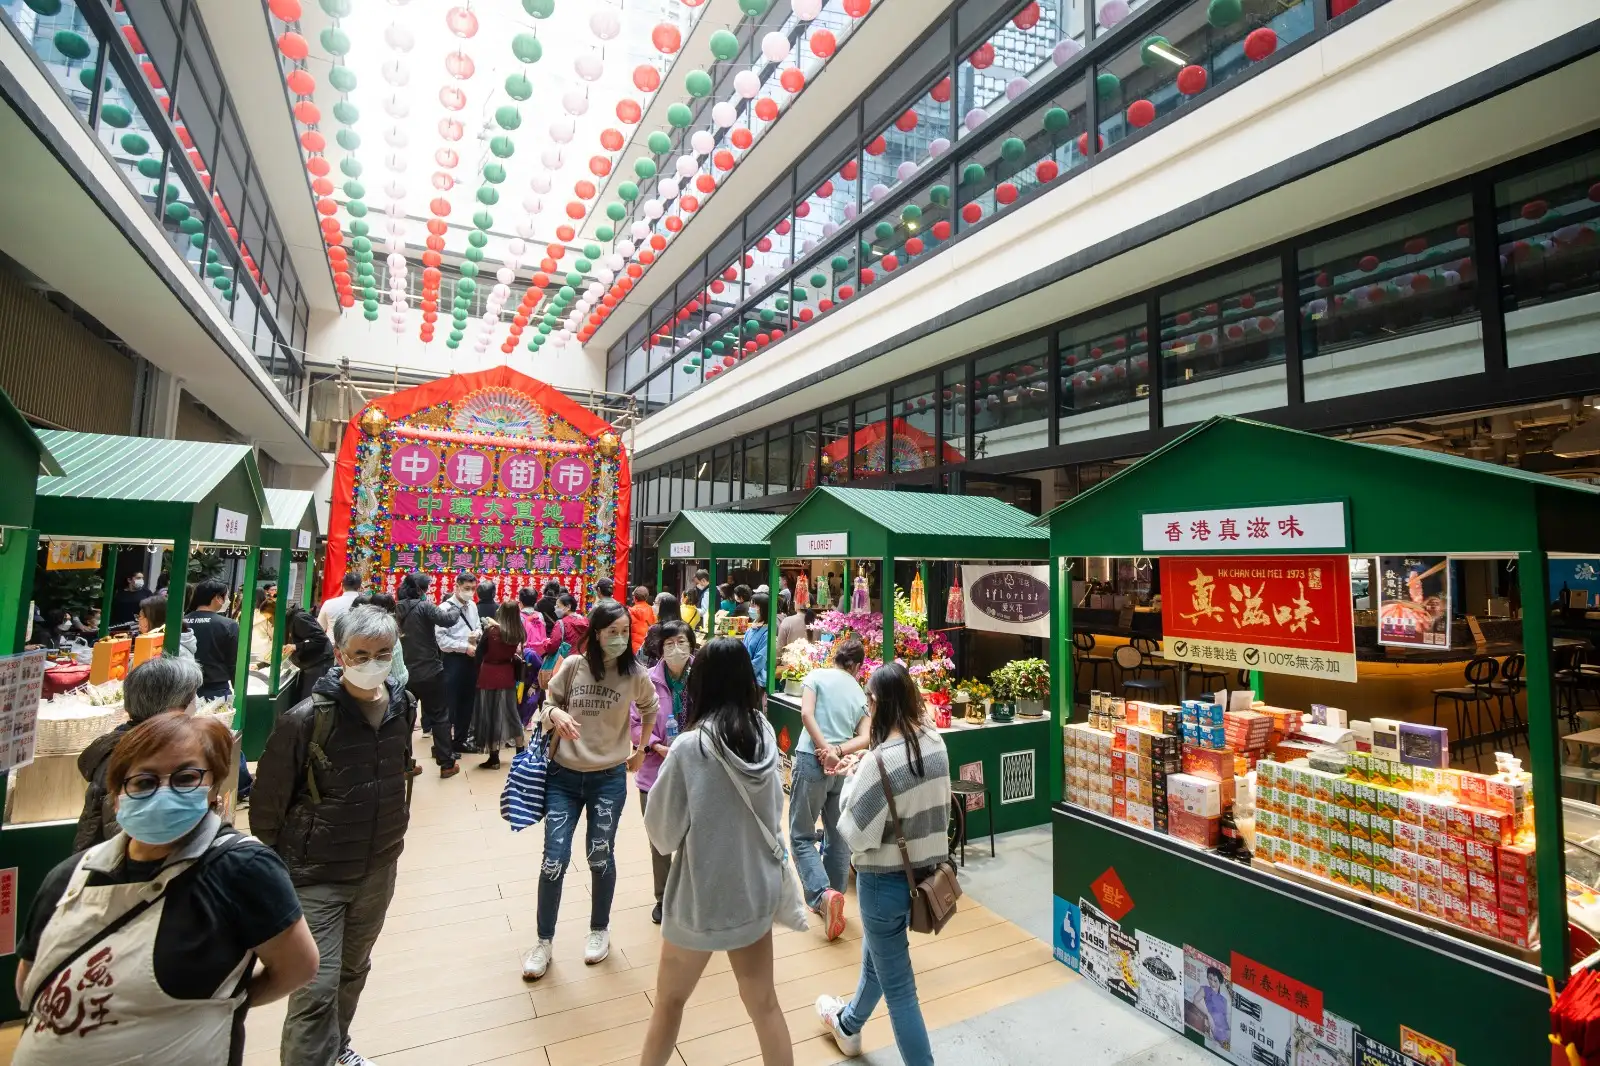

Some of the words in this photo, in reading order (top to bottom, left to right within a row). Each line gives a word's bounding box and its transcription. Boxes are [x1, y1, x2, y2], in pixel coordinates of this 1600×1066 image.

[401, 451, 584, 491] 中環街市
[1165, 514, 1304, 541] 香港真滋味
[1218, 569, 1229, 577] HK
[1231, 569, 1250, 578] CHAN
[1251, 570, 1265, 578] CHI
[1267, 570, 1283, 578] MEI
[1286, 570, 1305, 579] 1973
[986, 588, 1039, 600] iflorist
[1180, 568, 1320, 633] 真滋味
[1190, 645, 1237, 662] 香港製造
[572, 699, 612, 709] HABITAT
[1243, 964, 1309, 1008] 新春快樂
